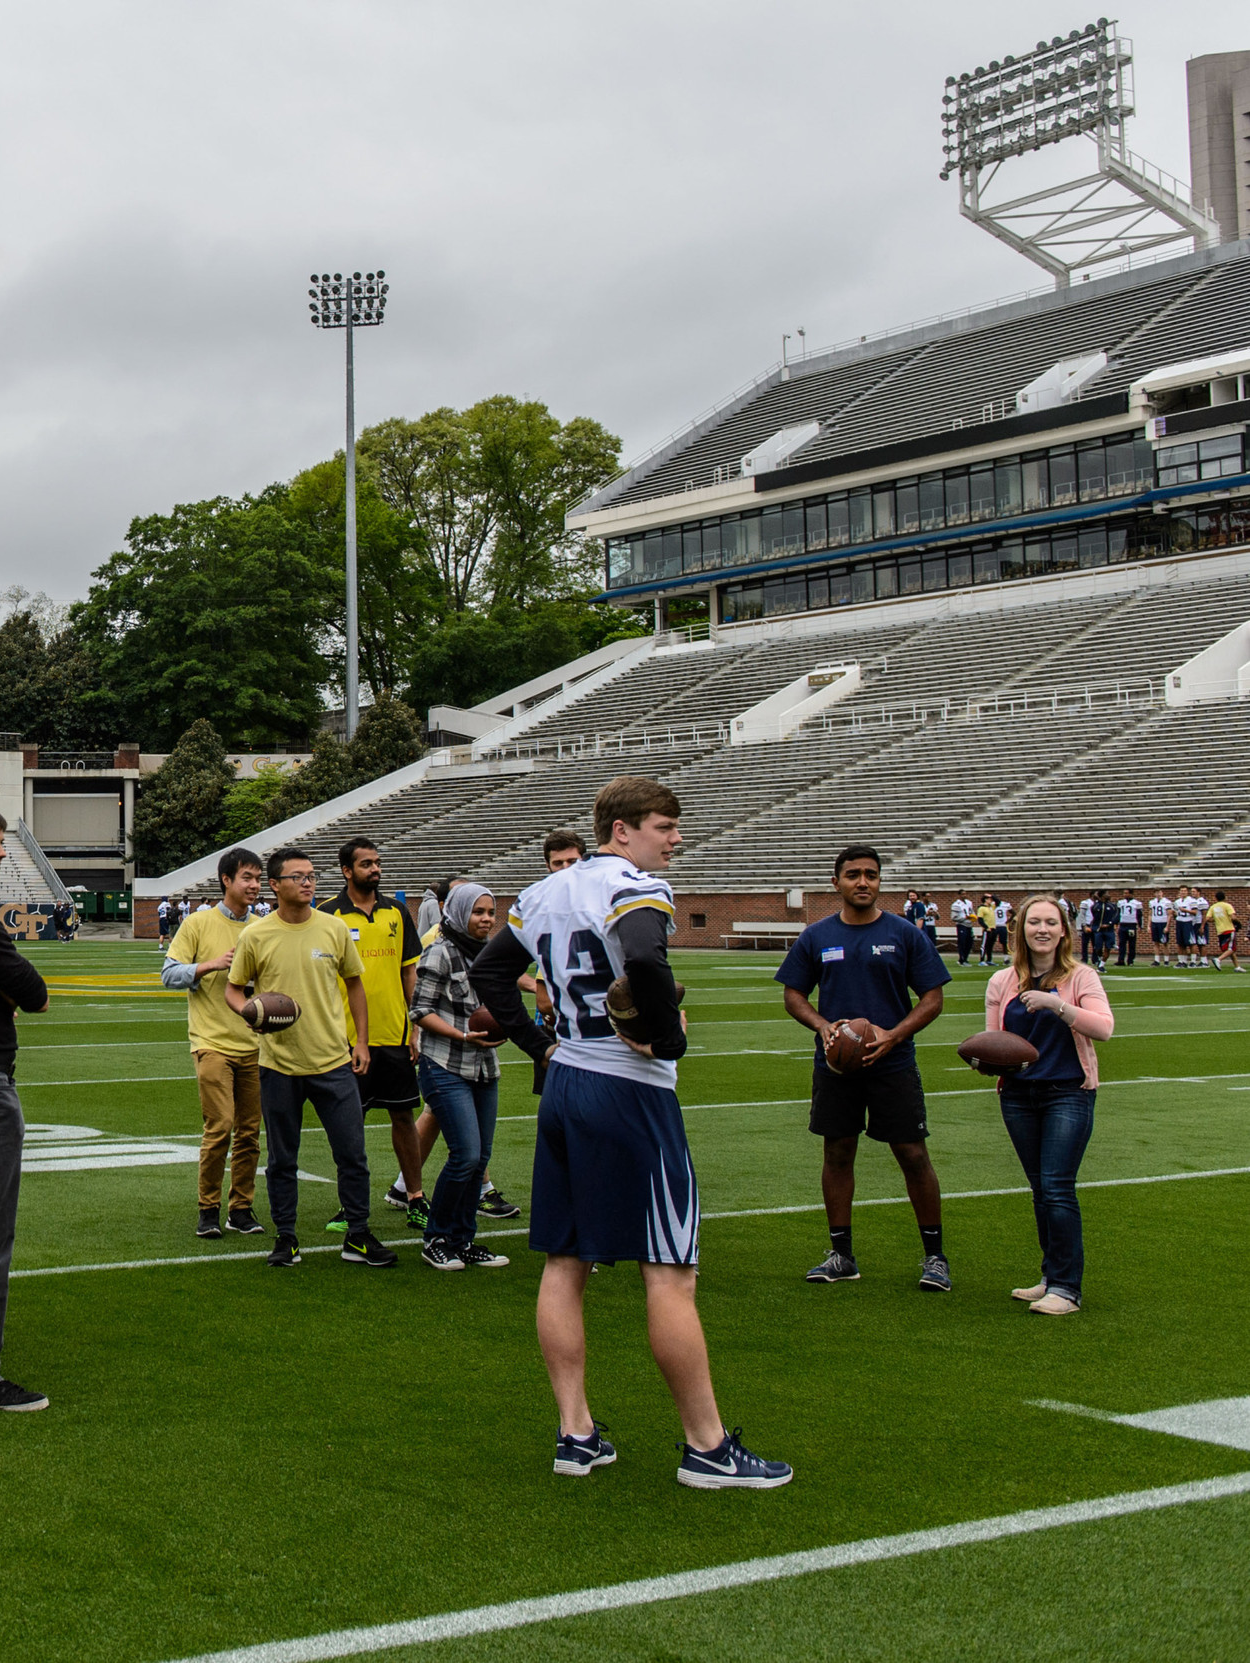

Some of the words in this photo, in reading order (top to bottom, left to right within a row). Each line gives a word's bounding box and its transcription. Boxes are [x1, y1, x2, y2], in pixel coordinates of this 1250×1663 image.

[1152, 905, 1164, 917] 18
[361, 948, 398, 959] LIQUOR
[537, 929, 619, 1040] 12
